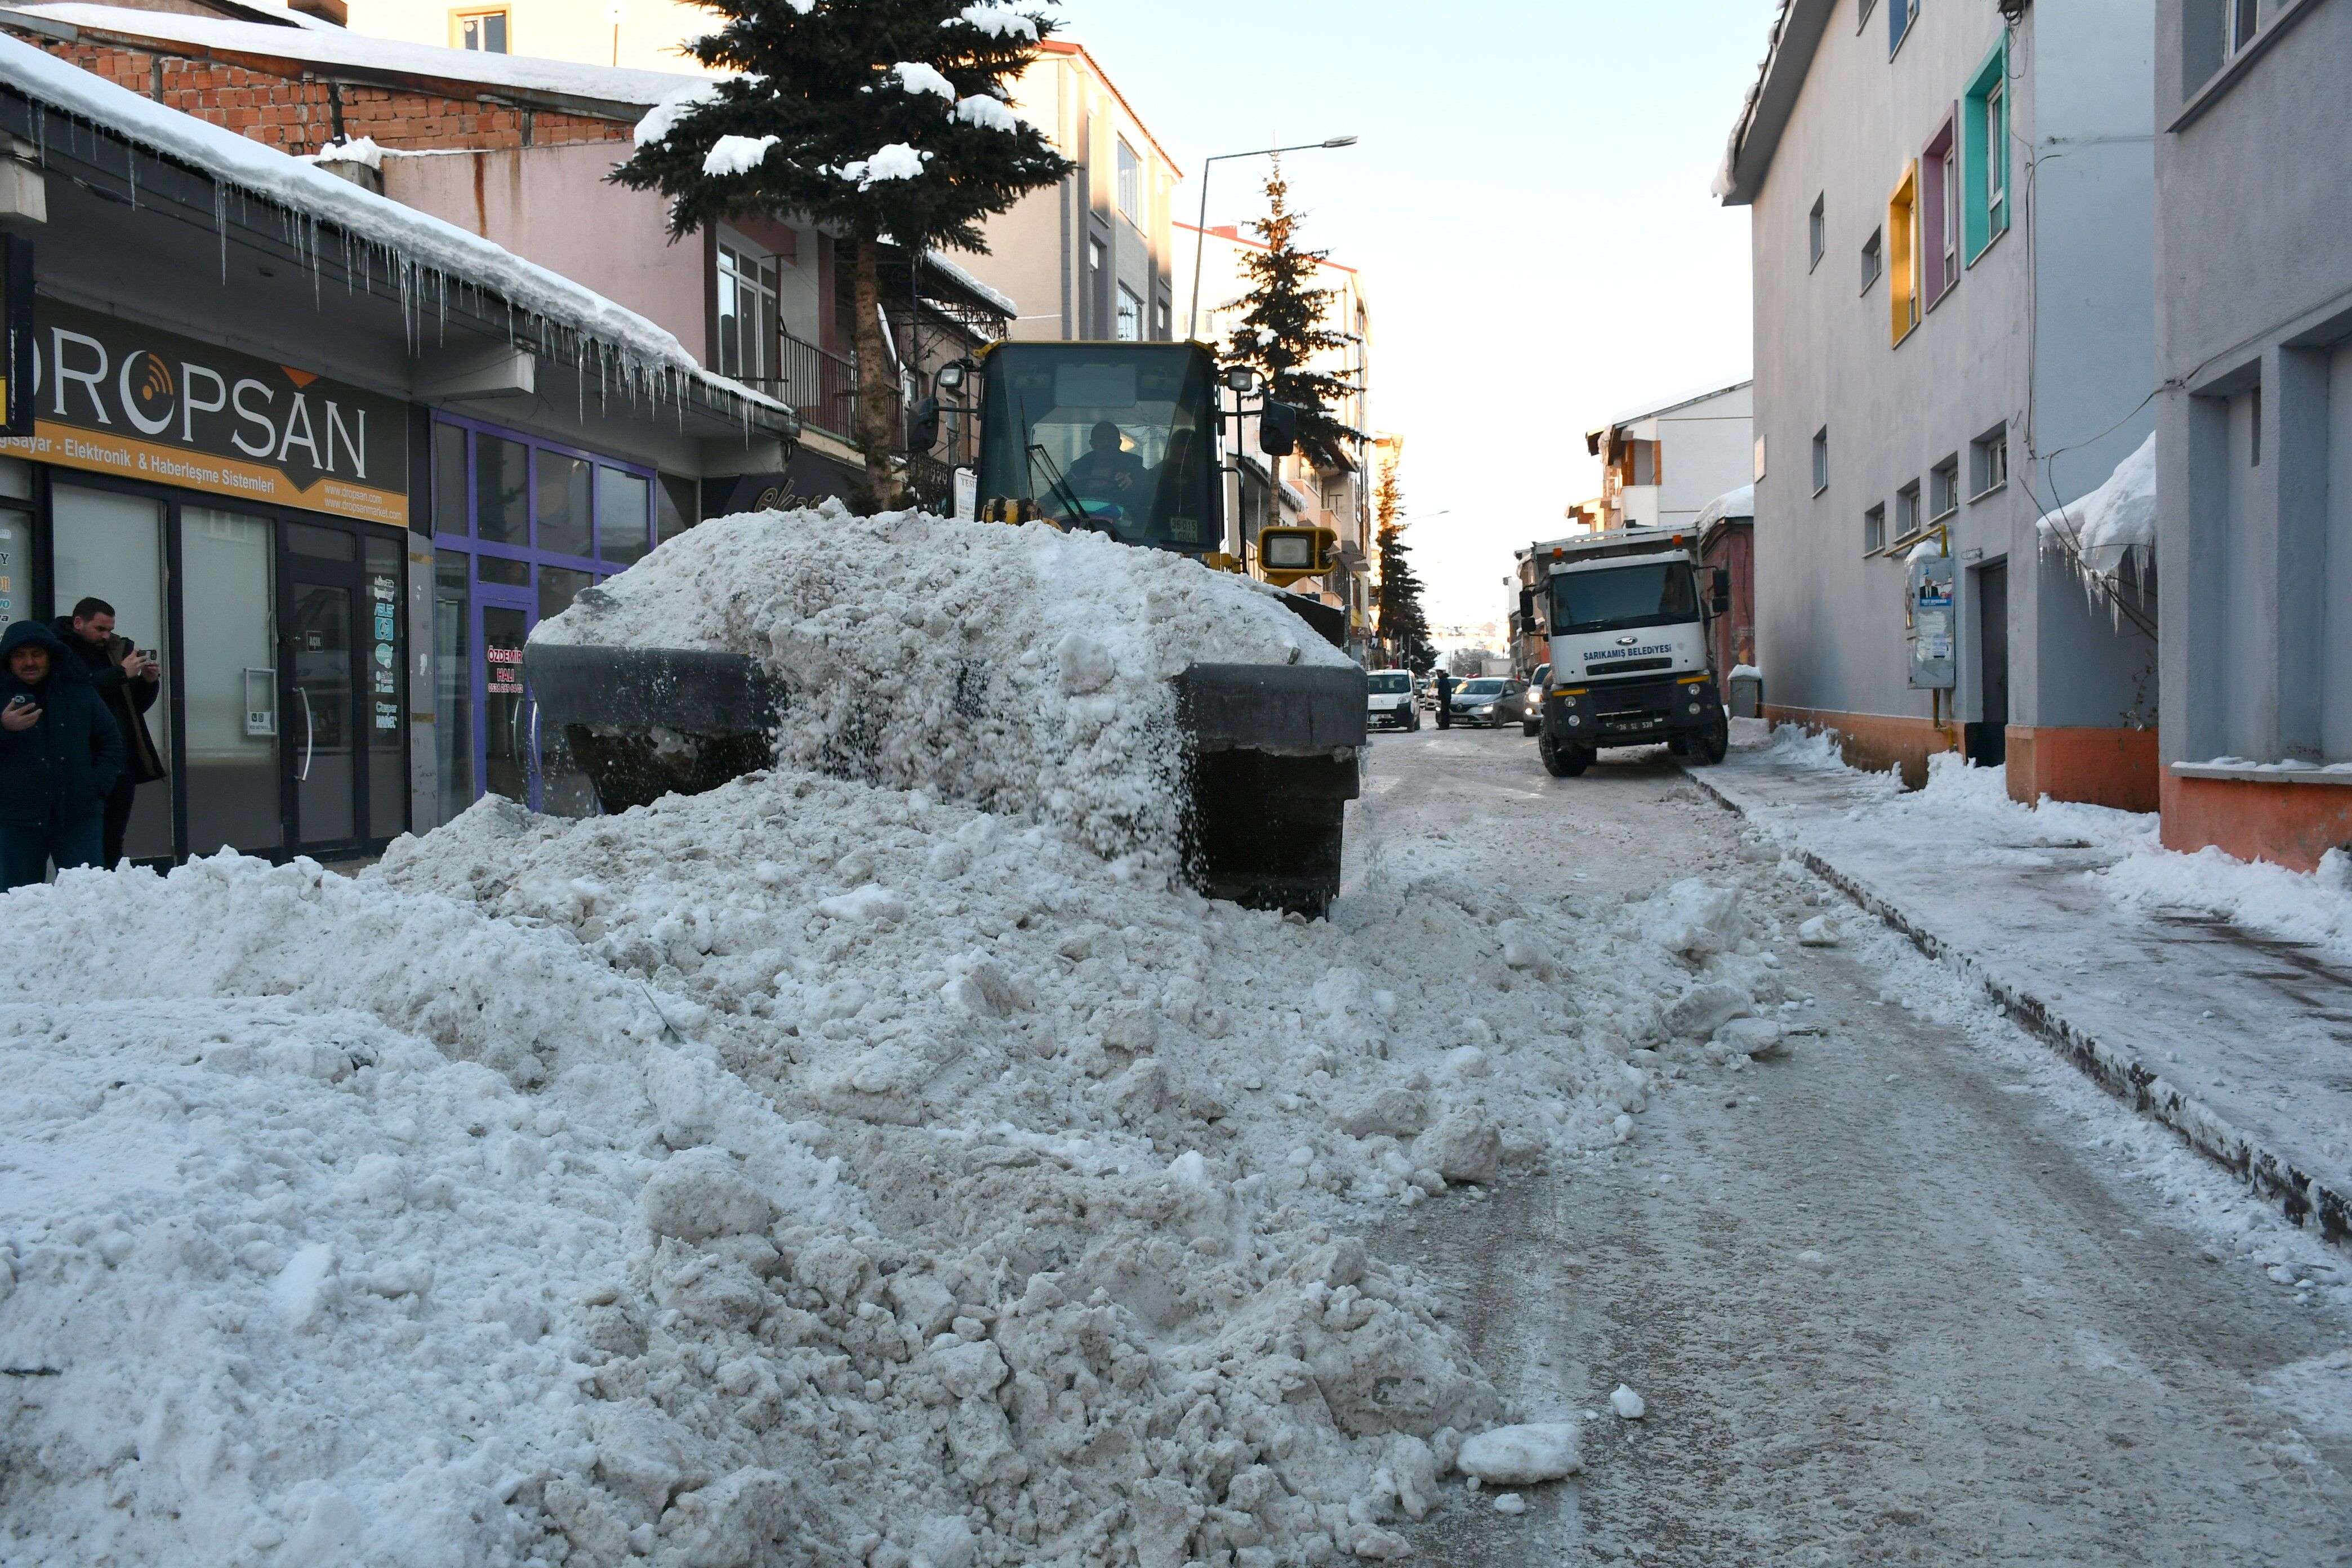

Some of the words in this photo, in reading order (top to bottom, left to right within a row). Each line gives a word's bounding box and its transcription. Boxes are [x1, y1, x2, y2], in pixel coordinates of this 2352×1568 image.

[34, 327, 366, 479] ROPSAN
[64, 438, 131, 466] Elektronik
[138, 453, 147, 470] &
[151, 456, 219, 484] Haberleşme
[222, 469, 275, 493] Sistemleri
[324, 485, 382, 504] www.dropsan.com
[324, 498, 402, 520] www.dropsanmarket.com
[488, 645, 523, 664] ÖZDEMİR
[1584, 648, 1625, 661] SARIKAMIŞ
[497, 668, 514, 682] HALI
[376, 701, 397, 716] Casper
